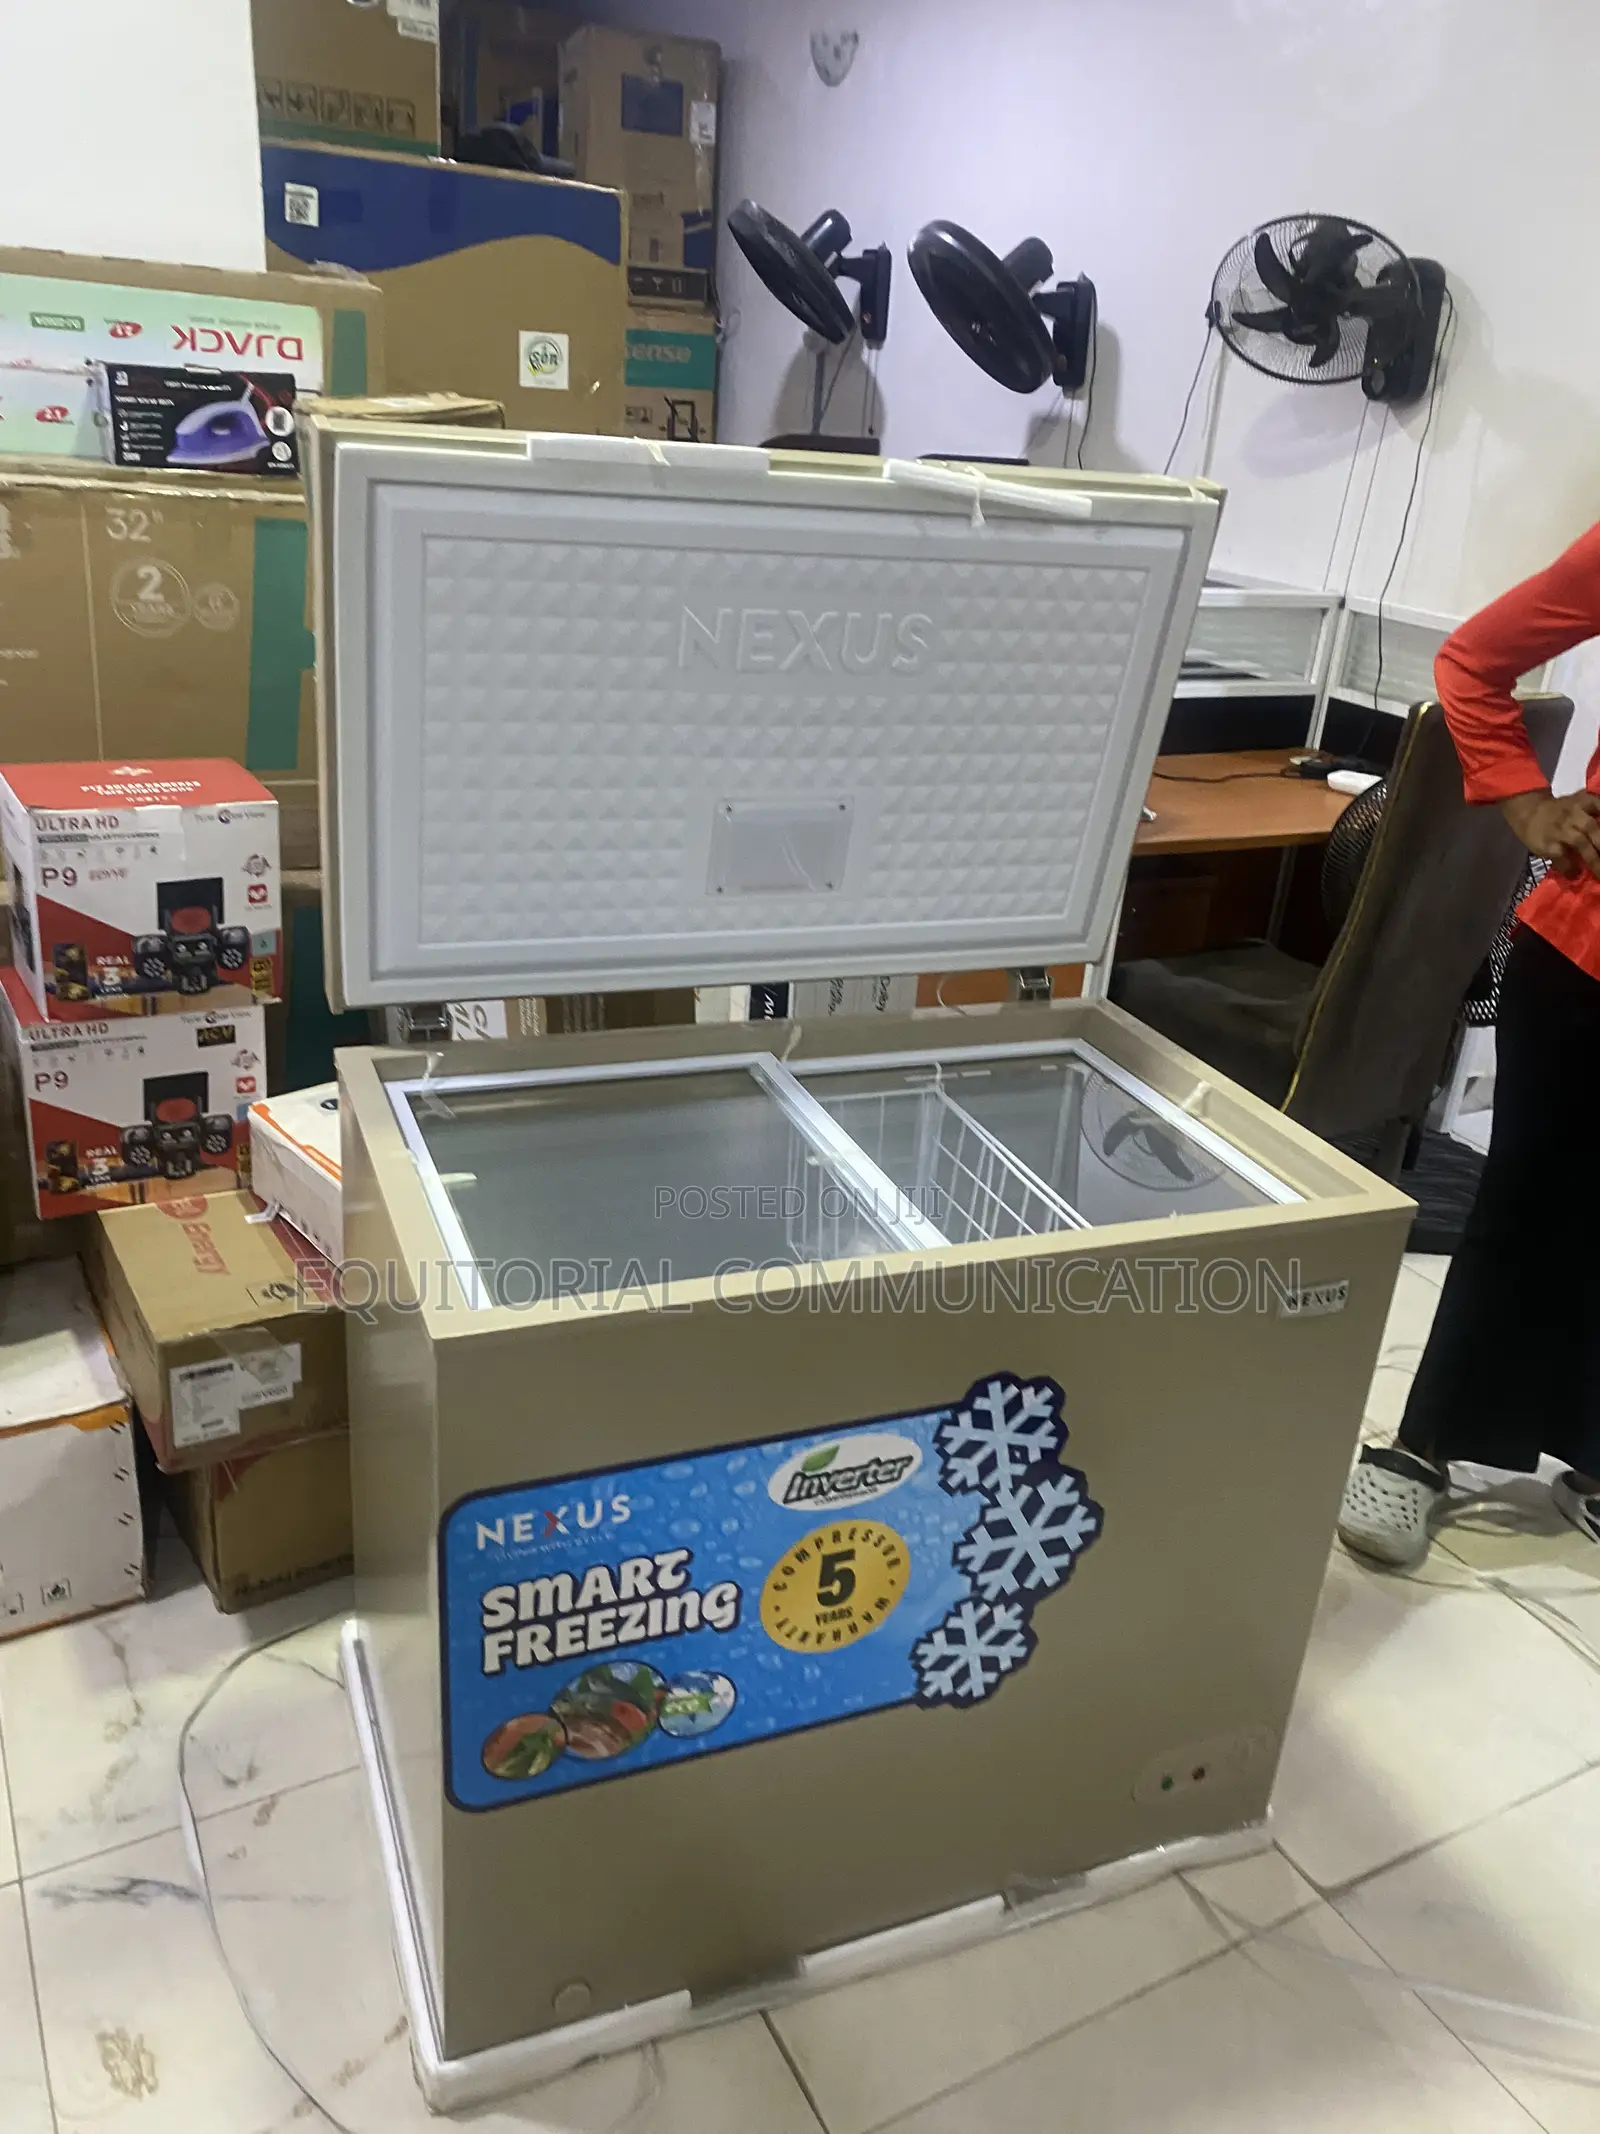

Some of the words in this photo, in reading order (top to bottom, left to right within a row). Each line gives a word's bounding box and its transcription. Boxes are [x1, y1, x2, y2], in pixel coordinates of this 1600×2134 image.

[137, 565, 165, 601] 2
[678, 605, 934, 675] NEXUS
[35, 815, 92, 832] ULTRA
[95, 814, 119, 829] HD
[41, 866, 78, 888] P9
[28, 1025, 83, 1041] ULTRA
[86, 1022, 109, 1036] HD
[34, 1070, 69, 1092] P9
[782, 1455, 914, 1504] Inverter
[475, 1493, 631, 1550] NEXUS
[772, 1526, 901, 1593] COMPRESSOR
[816, 1547, 857, 1608] 5
[775, 1596, 891, 1645] WARRANTY
[814, 1606, 854, 1627] YEARS
